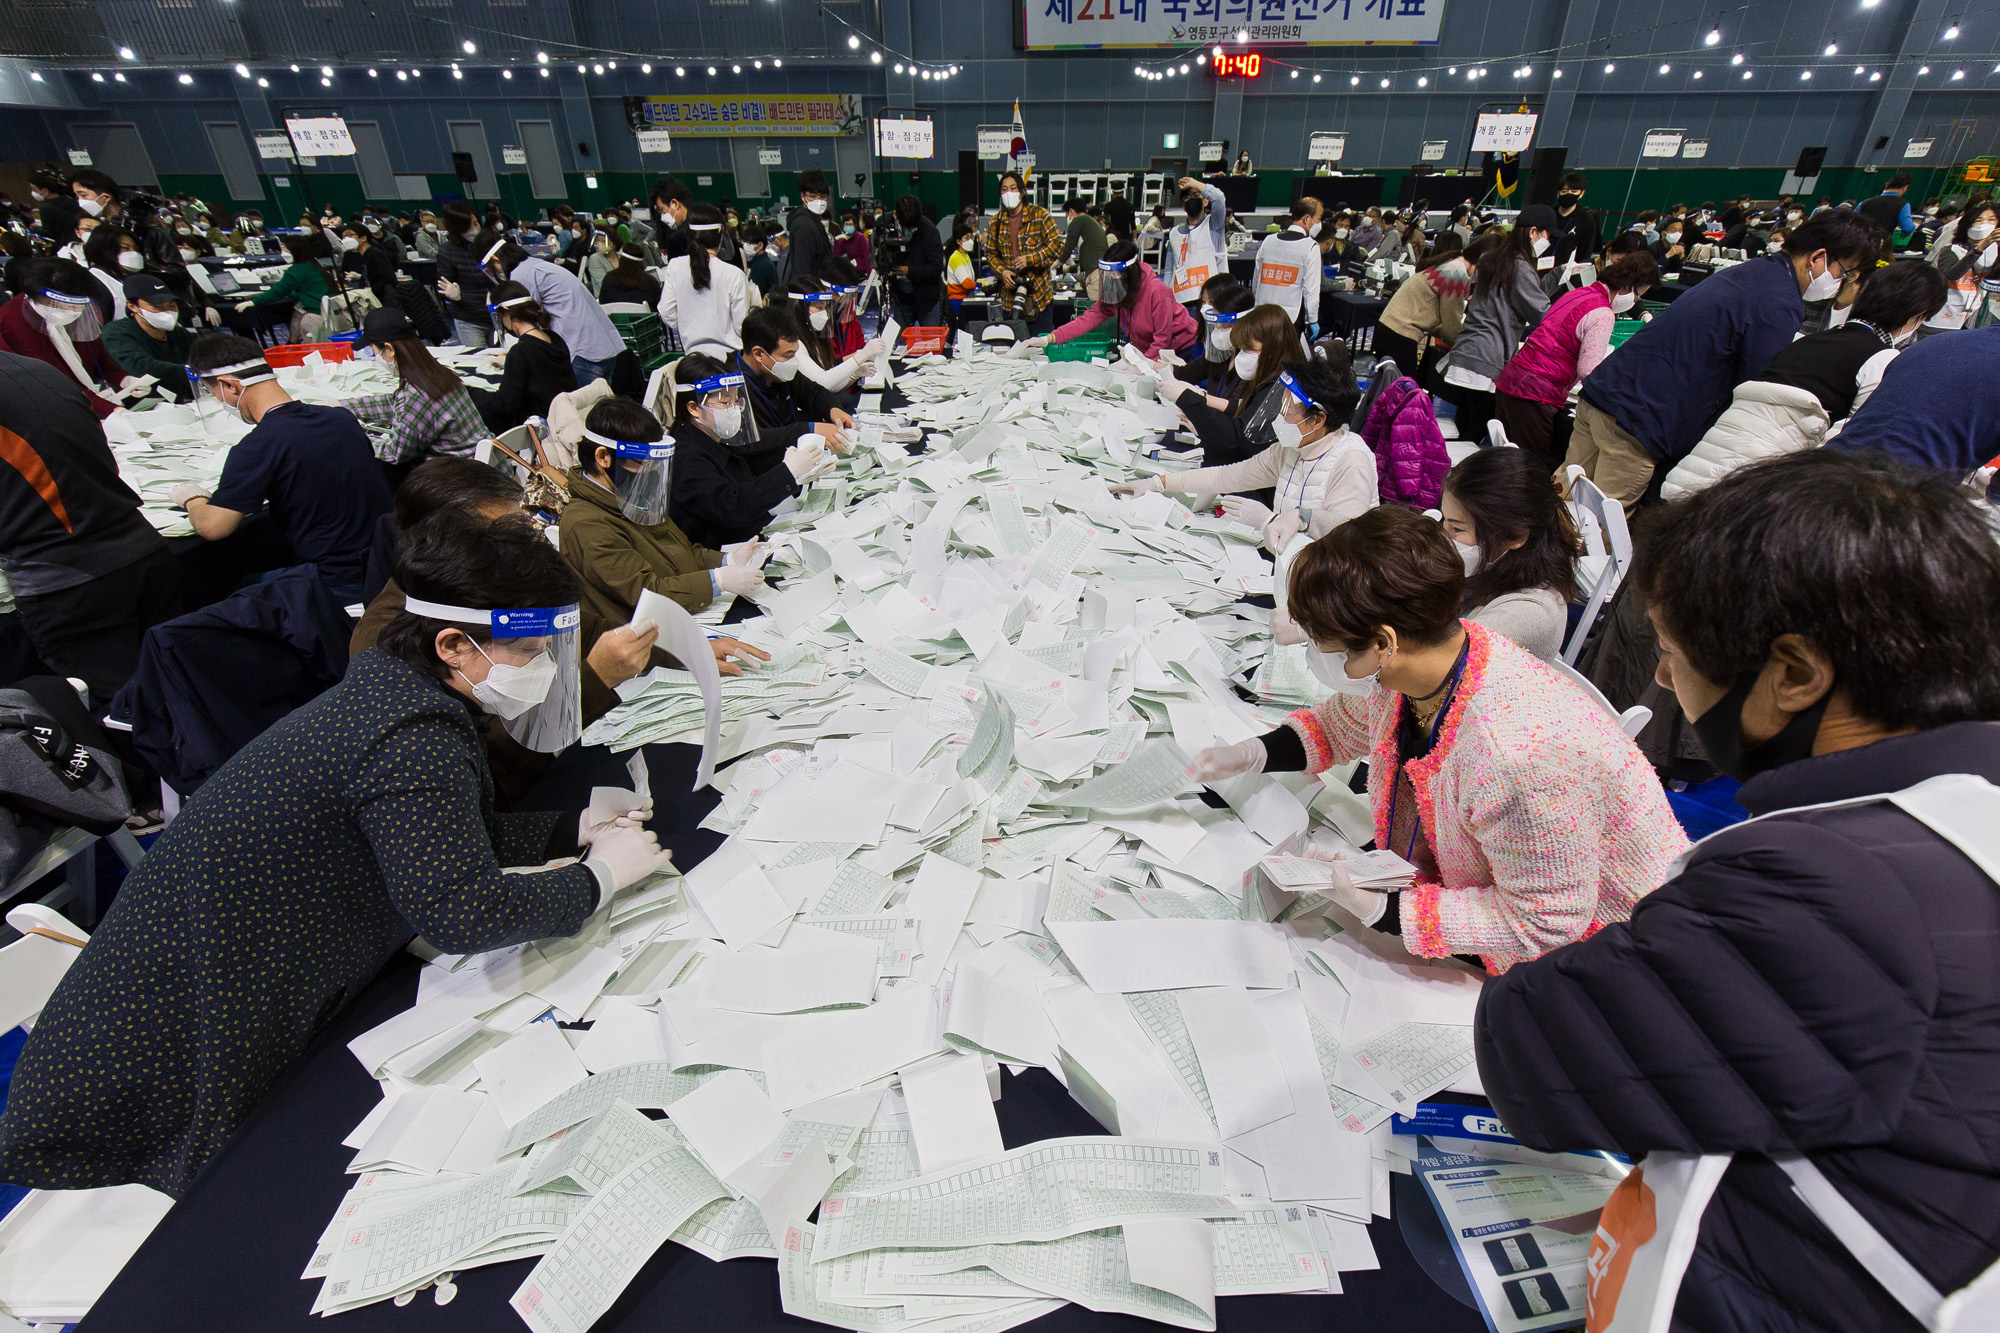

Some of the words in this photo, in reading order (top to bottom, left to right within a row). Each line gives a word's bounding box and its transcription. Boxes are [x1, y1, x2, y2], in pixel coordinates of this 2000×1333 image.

[1045, 0, 1146, 24] 제21대
[1214, 54, 1260, 76] 7:40
[642, 102, 681, 122] 배드민턴
[682, 101, 719, 121] 고수되는
[721, 101, 739, 121] 숨은
[740, 101, 767, 121] 비결!!
[768, 101, 805, 121] 배드민턴
[806, 101, 844, 121] 필라테스
[1477, 1119, 1508, 1134] Fac
[1420, 1154, 1472, 1168] 개함·점검부
